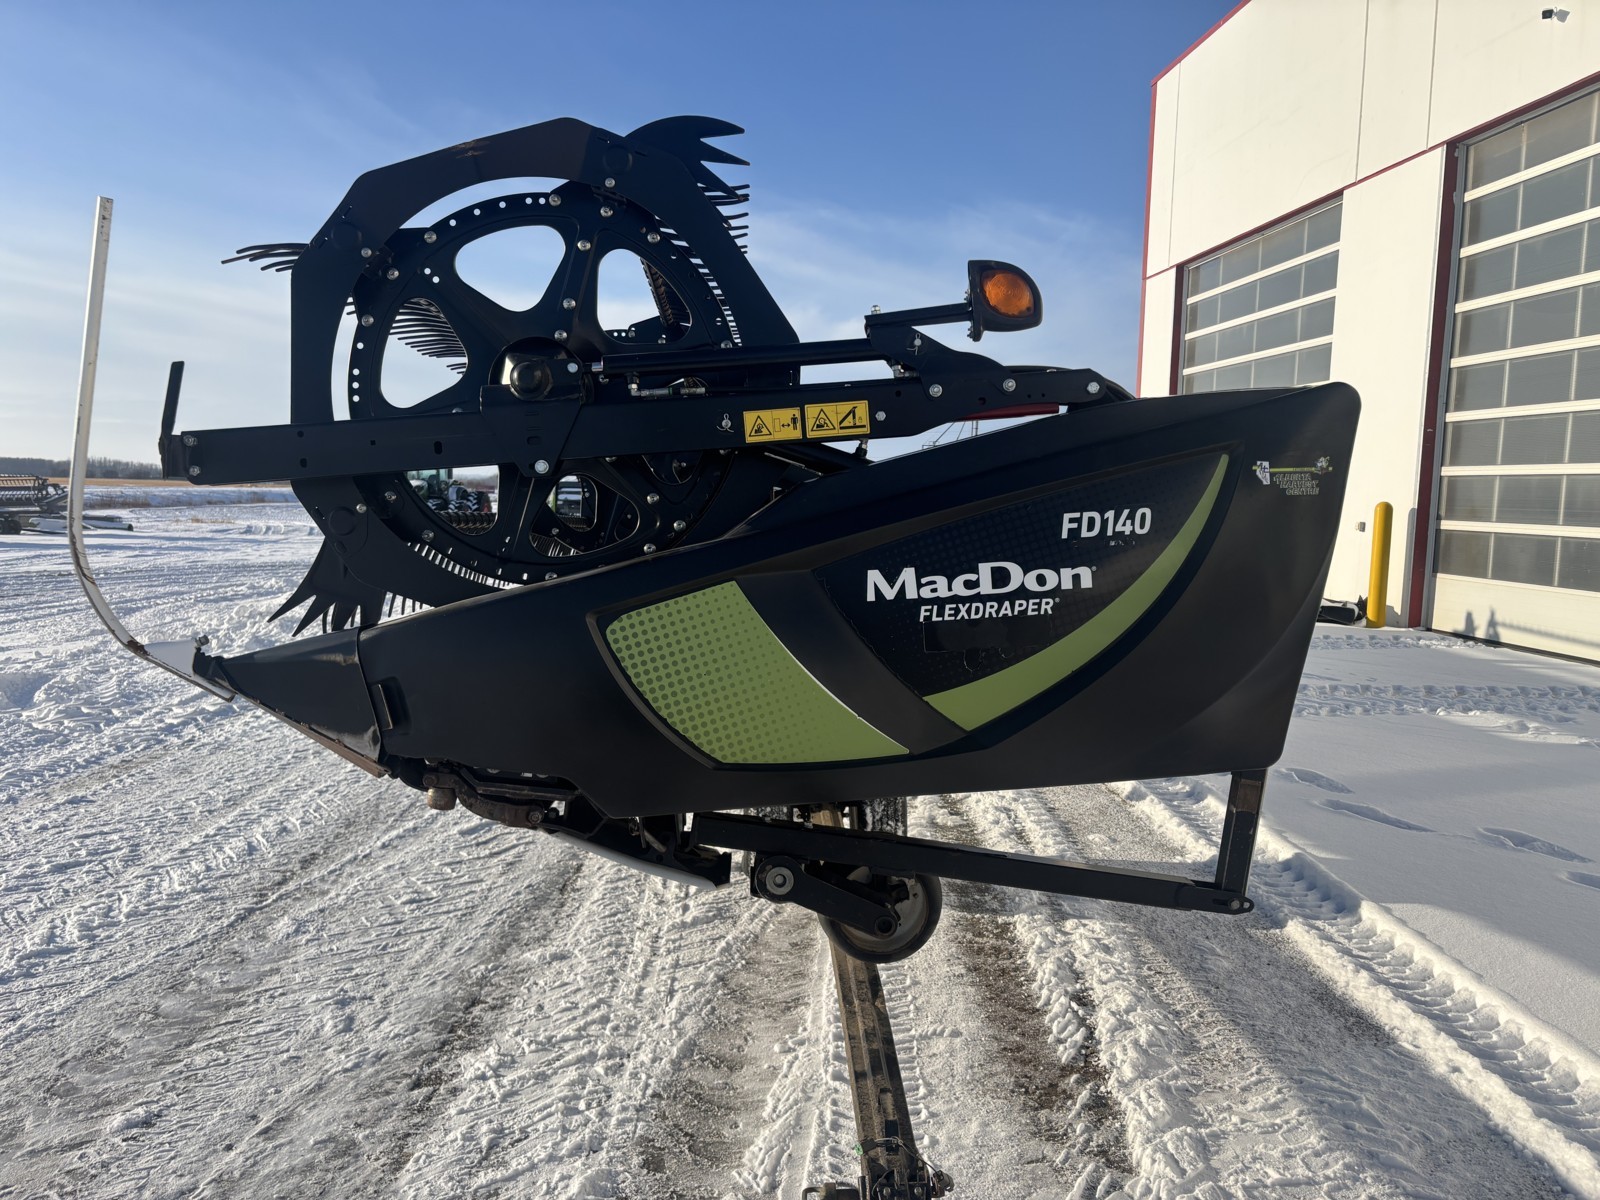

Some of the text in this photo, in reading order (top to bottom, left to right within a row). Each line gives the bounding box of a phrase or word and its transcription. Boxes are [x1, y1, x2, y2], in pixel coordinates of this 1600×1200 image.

[1061, 507, 1152, 539] FD140
[866, 561, 1093, 602] MacDon
[919, 599, 1054, 623] FLEXDRAPER
